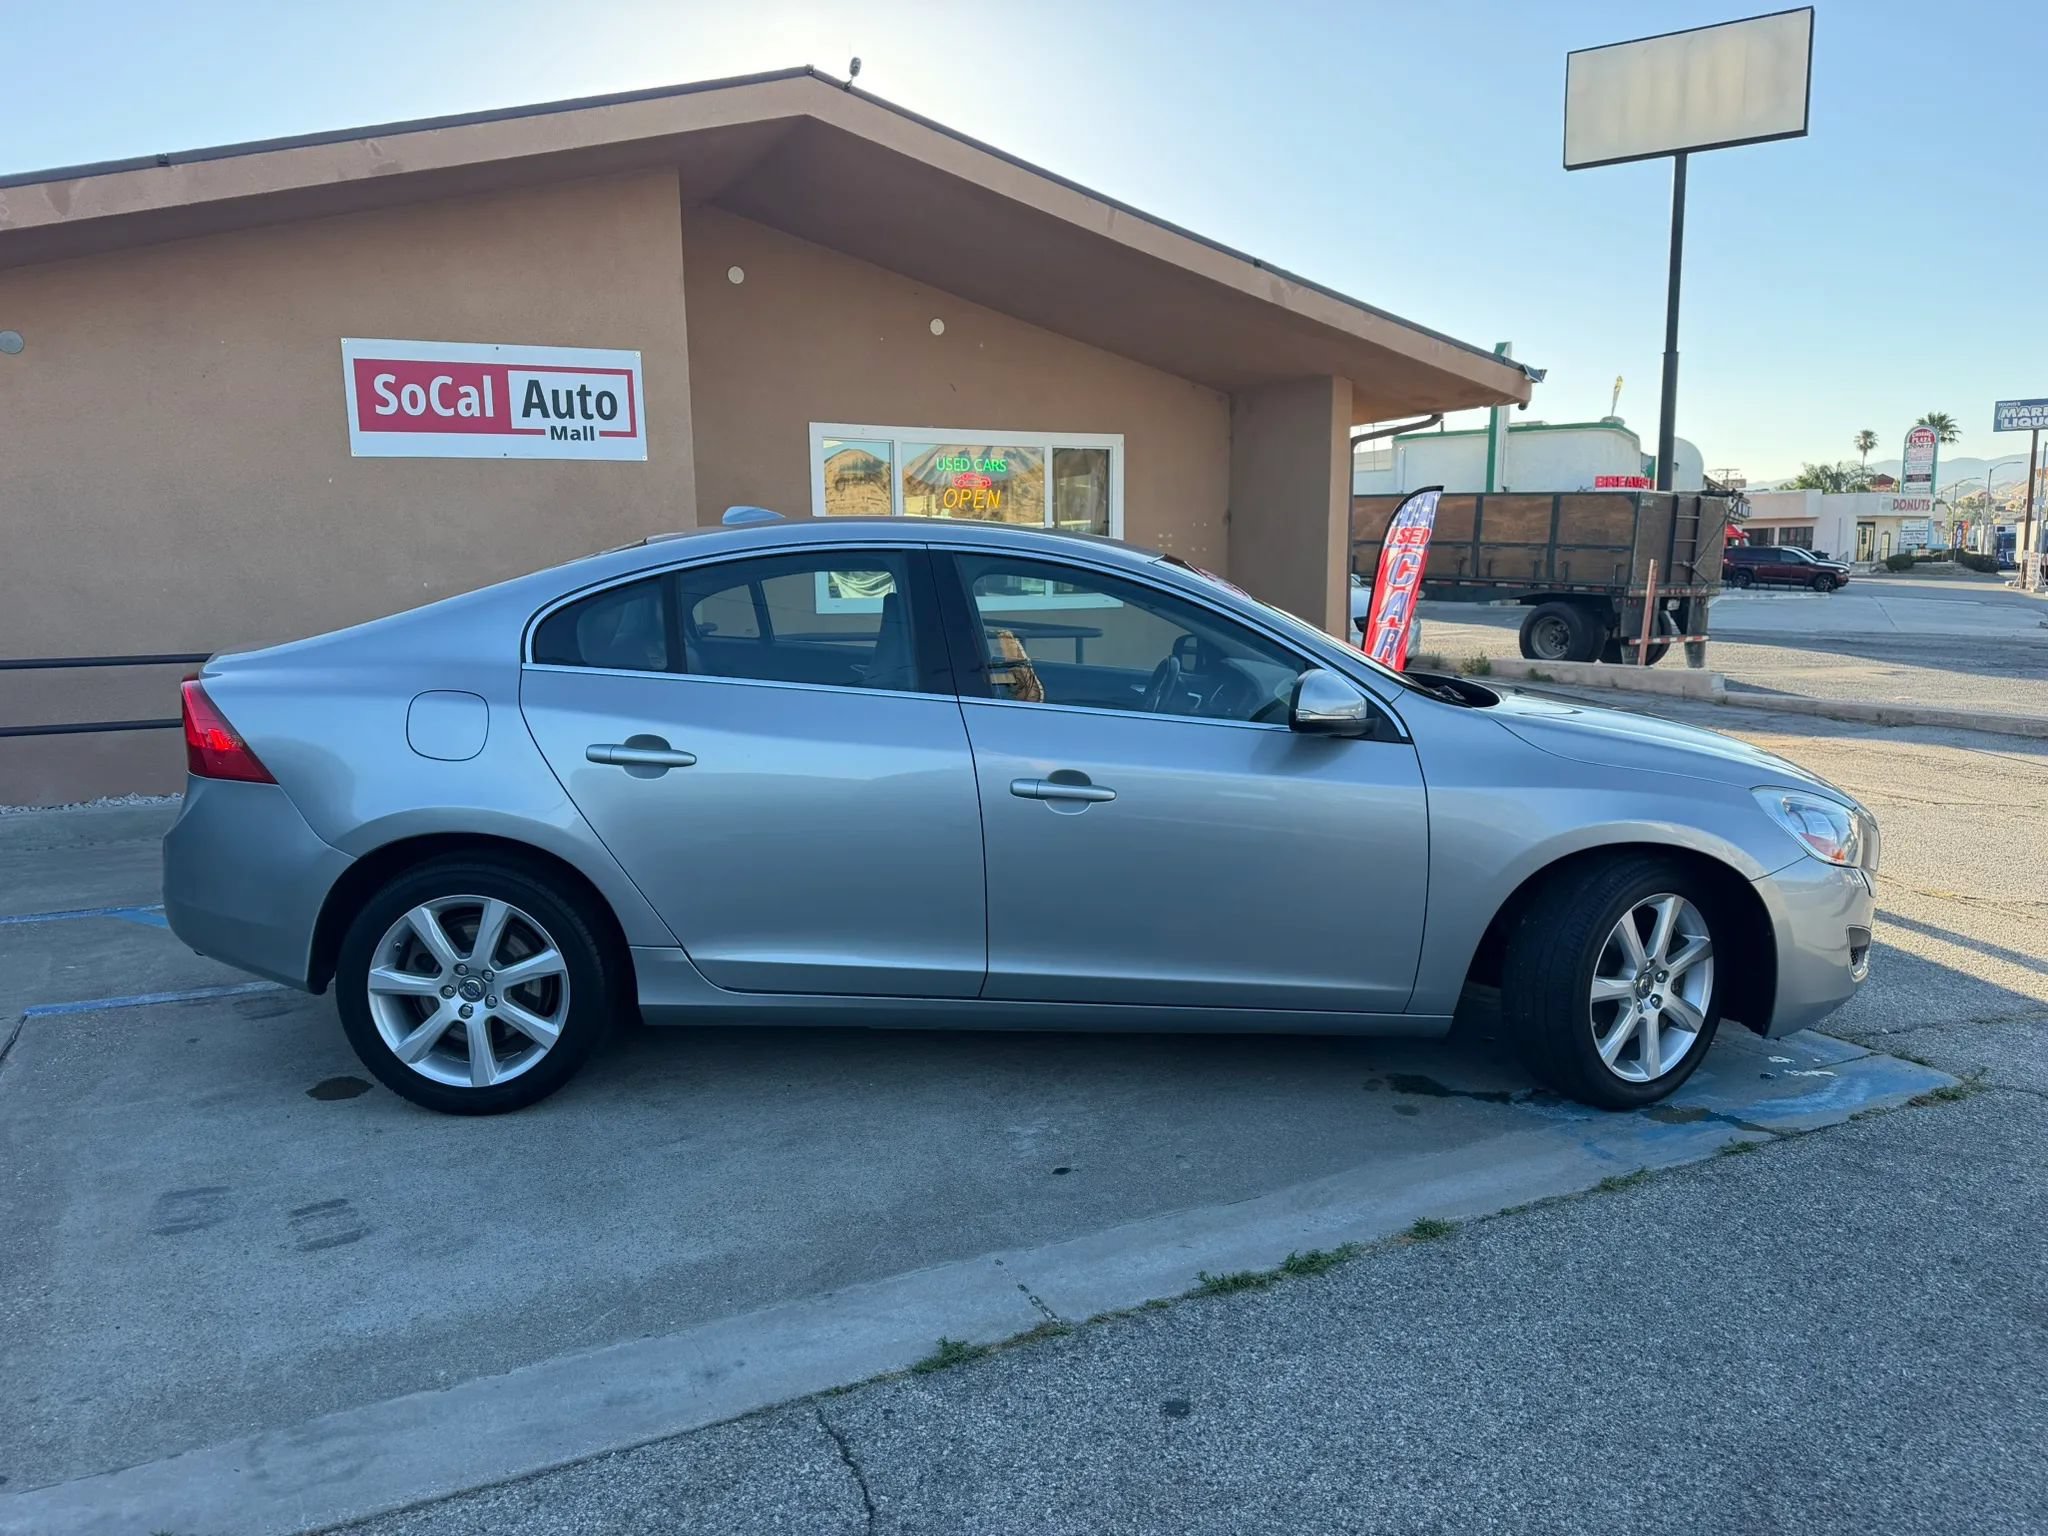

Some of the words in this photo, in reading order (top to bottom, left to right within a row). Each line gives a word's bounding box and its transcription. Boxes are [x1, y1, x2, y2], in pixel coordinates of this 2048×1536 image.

[373, 373, 494, 418] SoCal
[521, 379, 618, 421] Auto
[549, 425, 595, 441] Mall
[936, 457, 970, 472] USED
[974, 459, 1007, 472] CARS
[943, 488, 1001, 509] OPEN
[1892, 498, 1930, 511] DONUTS
